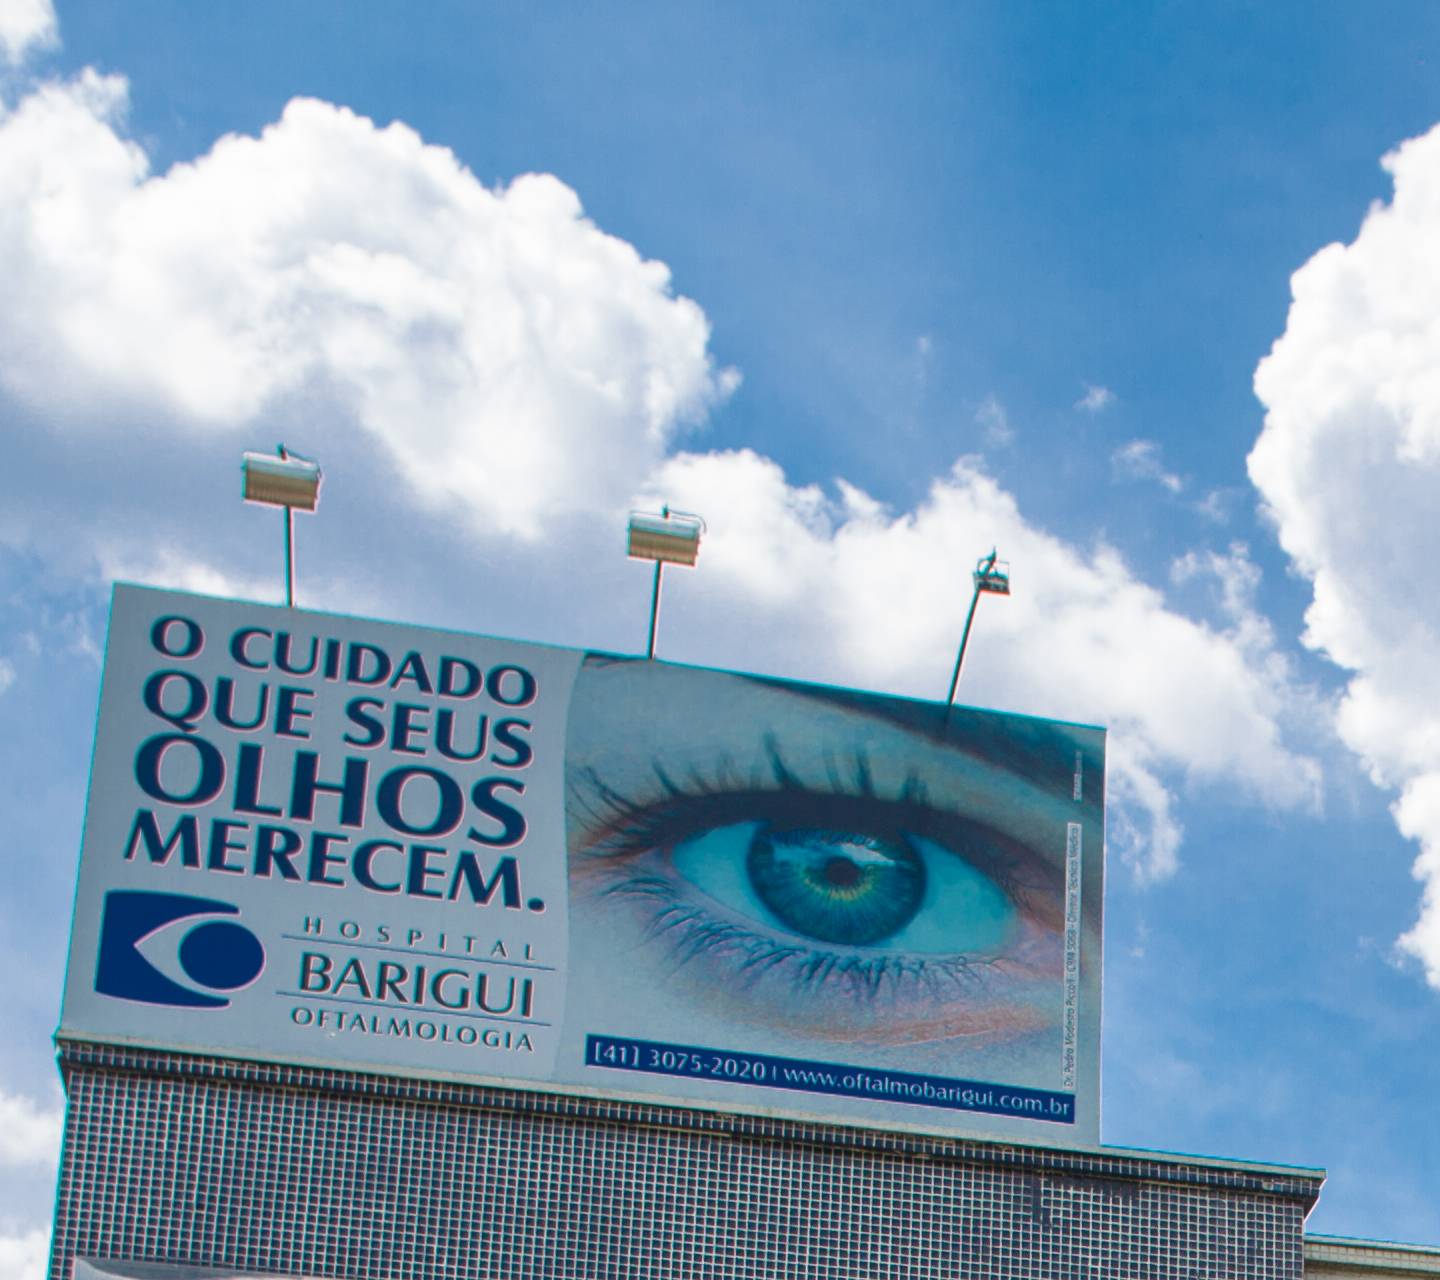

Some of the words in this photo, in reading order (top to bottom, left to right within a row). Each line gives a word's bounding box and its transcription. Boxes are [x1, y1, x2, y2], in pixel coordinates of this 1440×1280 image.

[150, 616, 205, 659] O
[230, 626, 538, 707] CUIDADO
[143, 669, 315, 740] QUE
[343, 696, 535, 769] SEUS
[134, 732, 529, 849] OLHOS
[124, 809, 547, 913] MERECEM.
[303, 916, 536, 961] HOSPITAL
[299, 951, 535, 1018] BARIGUI
[292, 1007, 535, 1053] OFTALMOLOGIA
[1063, 1049, 1073, 1073] Pedro
[648, 1049, 767, 1081] 3075-2020
[783, 1066, 1071, 1117] www.oftalmobarigui.com.br
